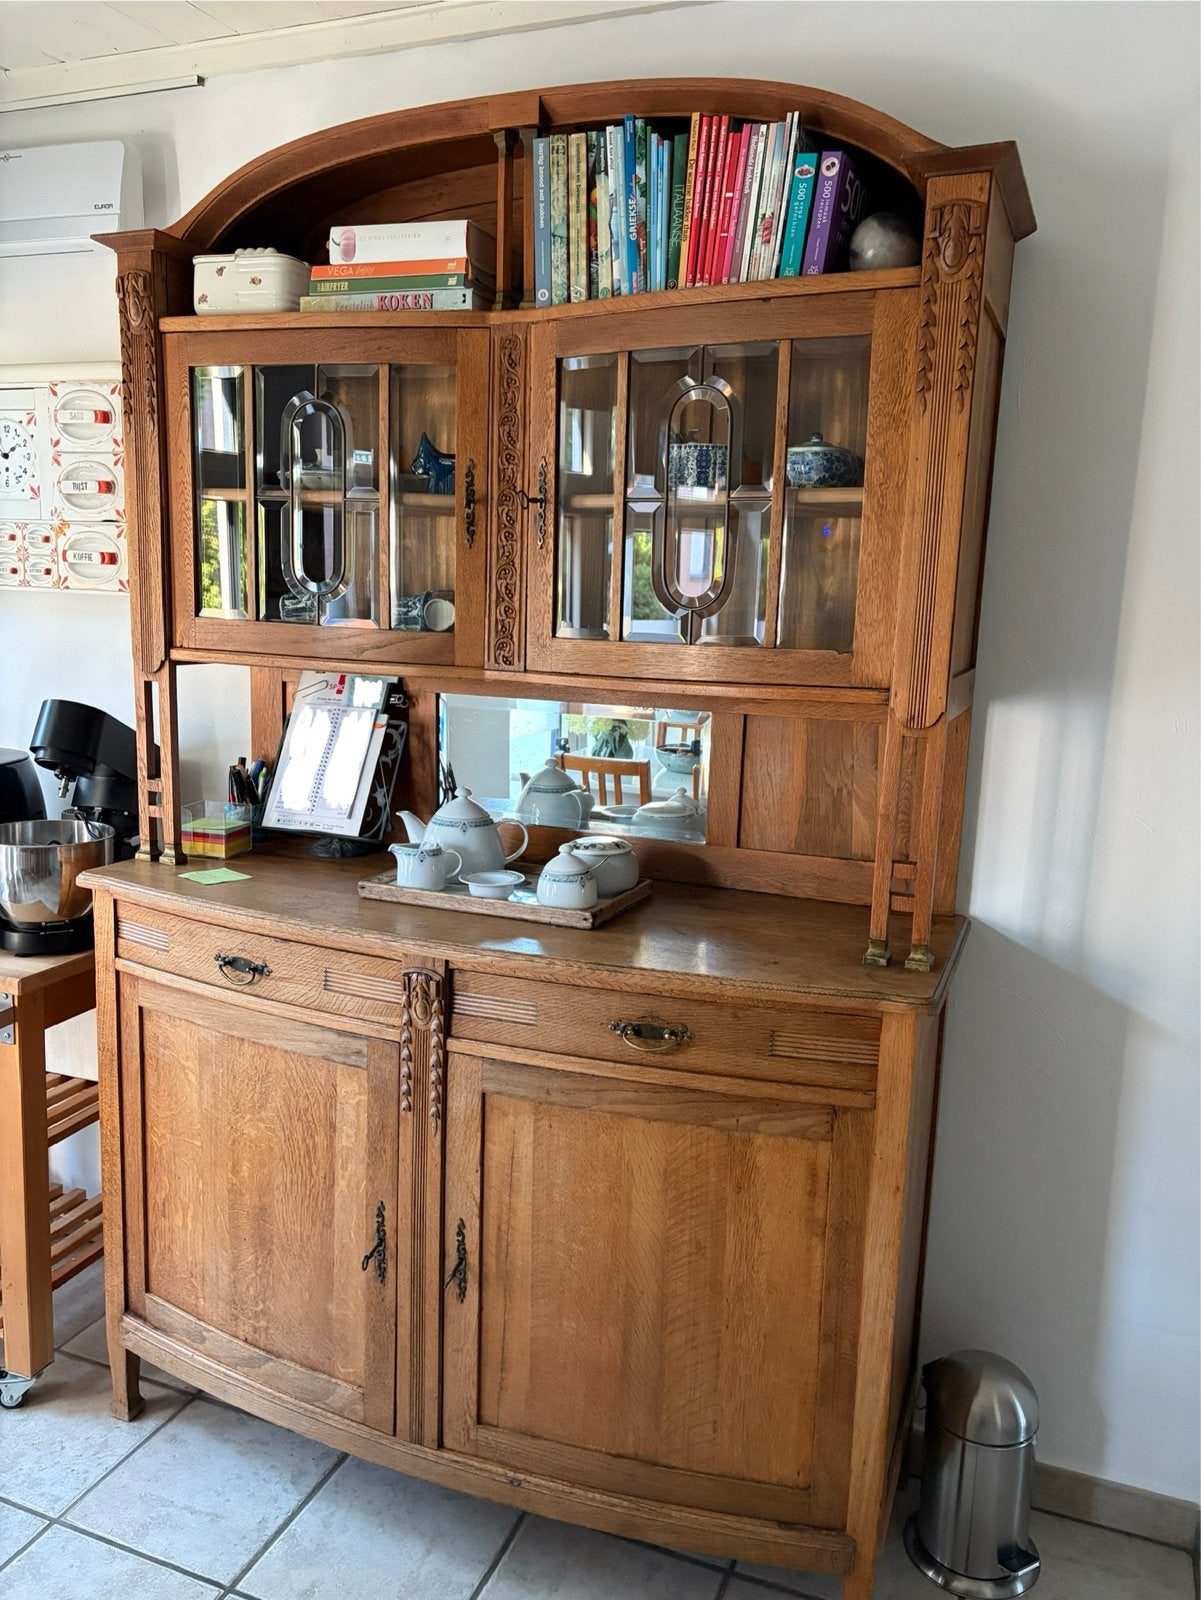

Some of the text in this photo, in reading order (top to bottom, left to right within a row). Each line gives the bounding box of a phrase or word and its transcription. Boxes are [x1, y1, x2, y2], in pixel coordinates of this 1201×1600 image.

[689, 158, 695, 170] De
[686, 170, 694, 196] warme
[797, 181, 807, 200] 500
[822, 179, 832, 198] 500
[671, 183, 684, 247] ITALIAANSE
[684, 196, 692, 222] bakker
[816, 198, 825, 229] recepten
[822, 198, 830, 223] inmaak
[629, 198, 637, 240] GRIEKSE
[790, 200, 799, 238] gerechten
[682, 223, 690, 242] thuis
[327, 266, 354, 276] VEGA
[320, 281, 349, 292] AIRFRYER
[376, 293, 434, 311] KOKEN
[69, 411, 84, 421] SAGO
[72, 481, 88, 492] RIJST
[72, 552, 93, 562] KOFFIE
